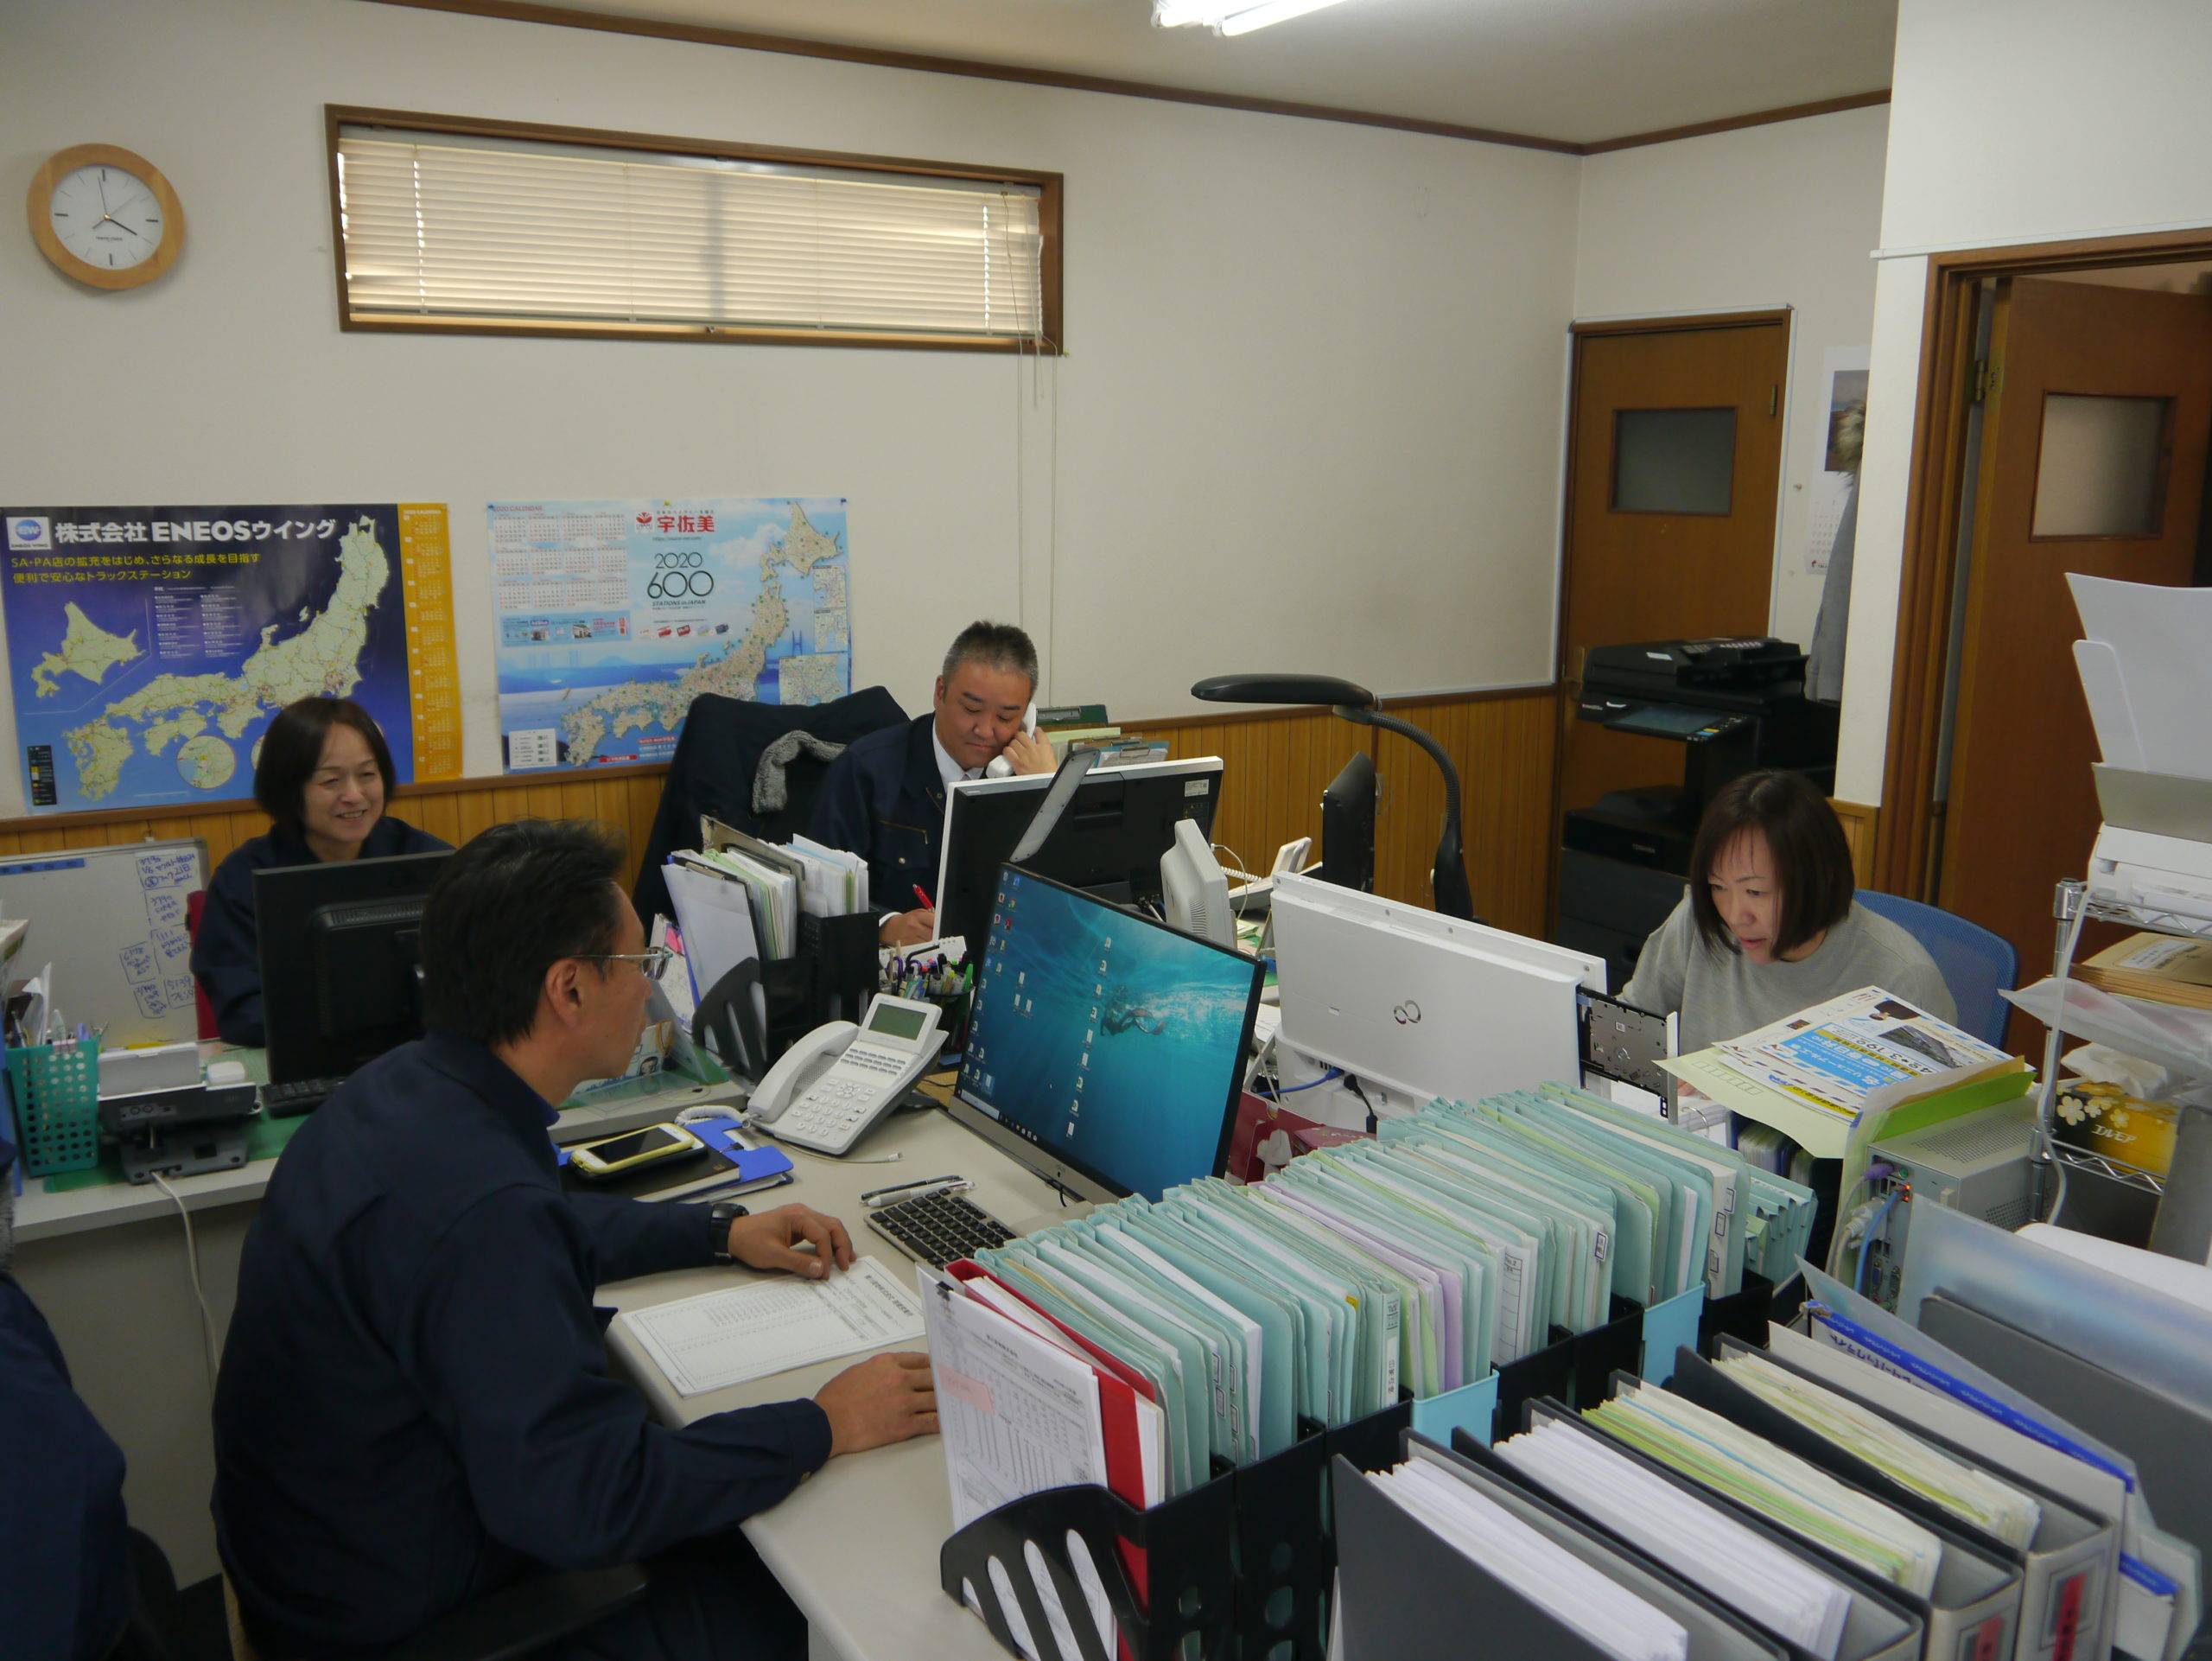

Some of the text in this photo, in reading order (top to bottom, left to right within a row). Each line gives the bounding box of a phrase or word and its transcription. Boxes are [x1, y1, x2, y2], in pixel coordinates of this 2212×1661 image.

[657, 515, 715, 533] 宇佐美
[654, 552, 703, 569] 2020
[13, 570, 192, 584] 便利で安心なトラックステーション
[646, 570, 715, 599] 600
